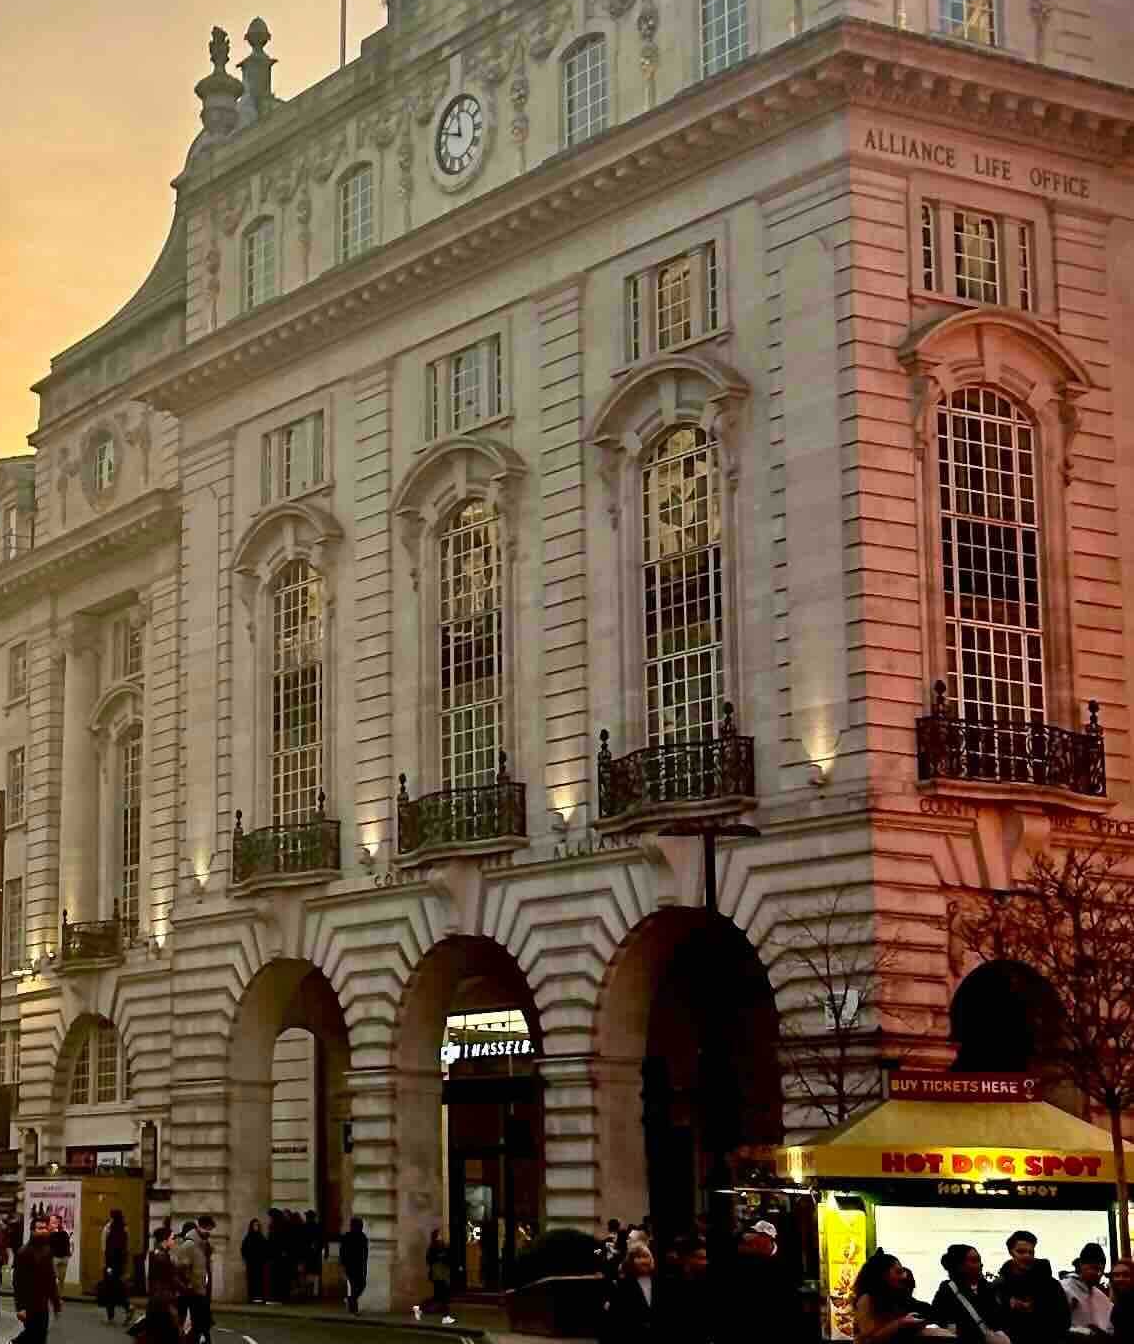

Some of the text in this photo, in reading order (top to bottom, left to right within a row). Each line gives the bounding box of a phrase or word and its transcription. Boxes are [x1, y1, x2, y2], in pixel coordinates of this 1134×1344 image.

[865, 129, 1090, 199] ALLIANCE LIFE OFFICE
[891, 1079, 1019, 1094] BUY TICKETS HERE
[882, 1152, 1102, 1177] HOT DOG SPOT
[938, 1183, 971, 1195] HOT
[1017, 1184, 1058, 1197] SPOT
